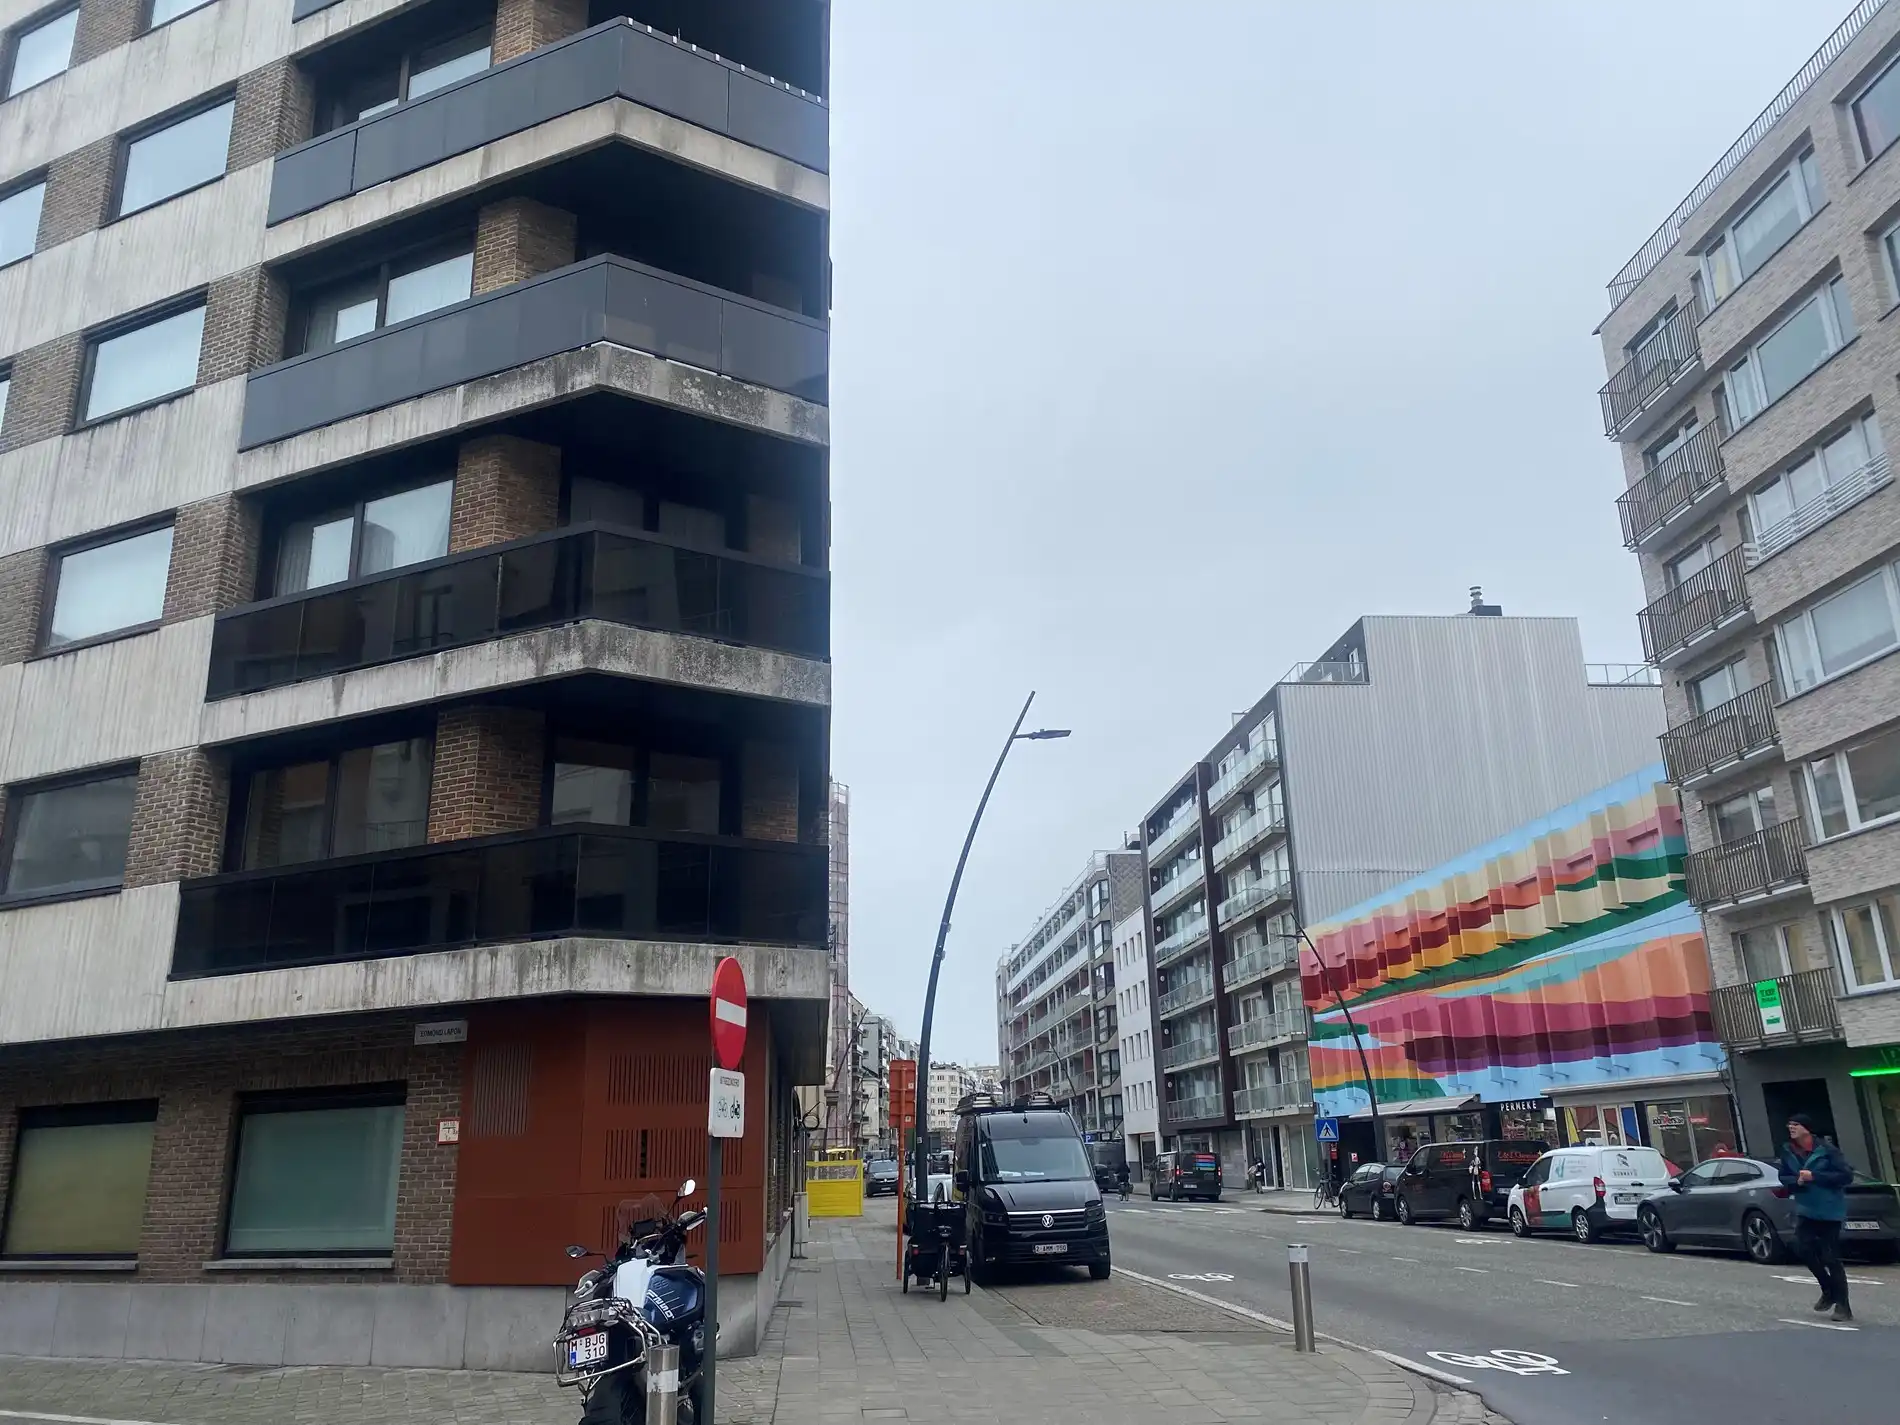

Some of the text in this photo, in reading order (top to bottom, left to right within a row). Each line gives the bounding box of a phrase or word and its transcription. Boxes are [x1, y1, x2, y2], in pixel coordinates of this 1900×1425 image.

[1500, 1100, 1537, 1112] PERMEKE
[585, 1333, 606, 1348] BJG
[585, 1345, 606, 1360] 310
